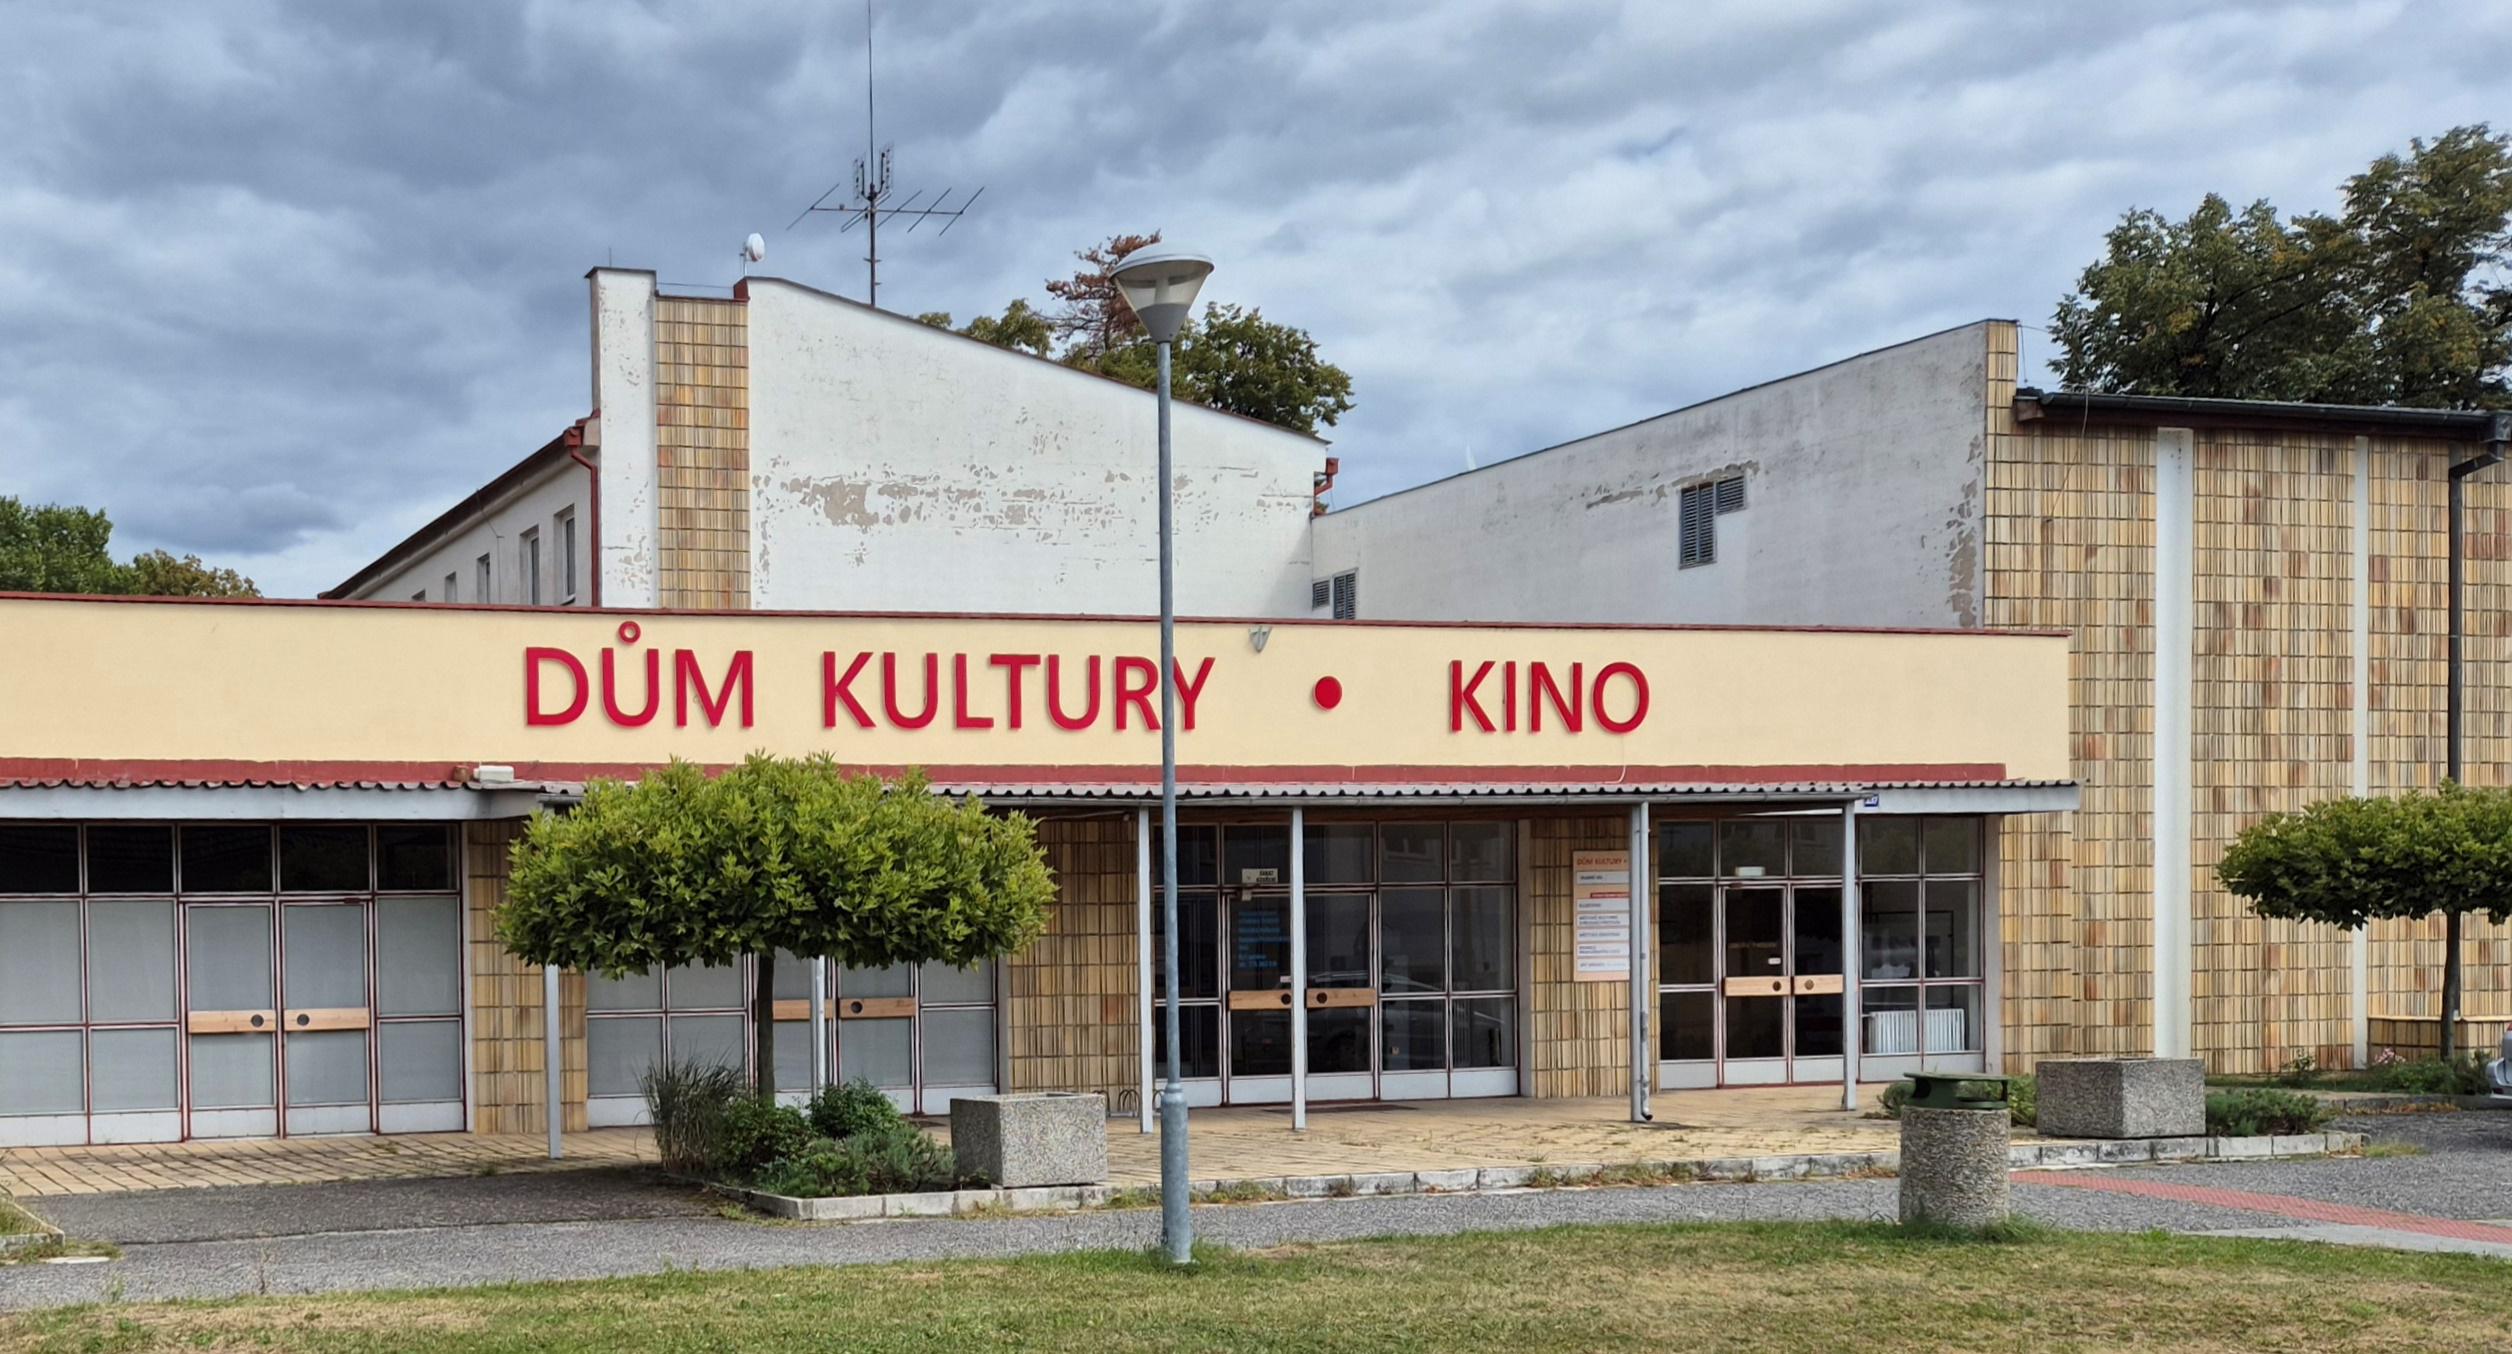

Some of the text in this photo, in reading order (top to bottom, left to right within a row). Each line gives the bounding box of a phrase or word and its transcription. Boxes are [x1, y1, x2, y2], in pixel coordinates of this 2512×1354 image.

[525, 620, 1650, 734] DŮM KULTURY KINO
